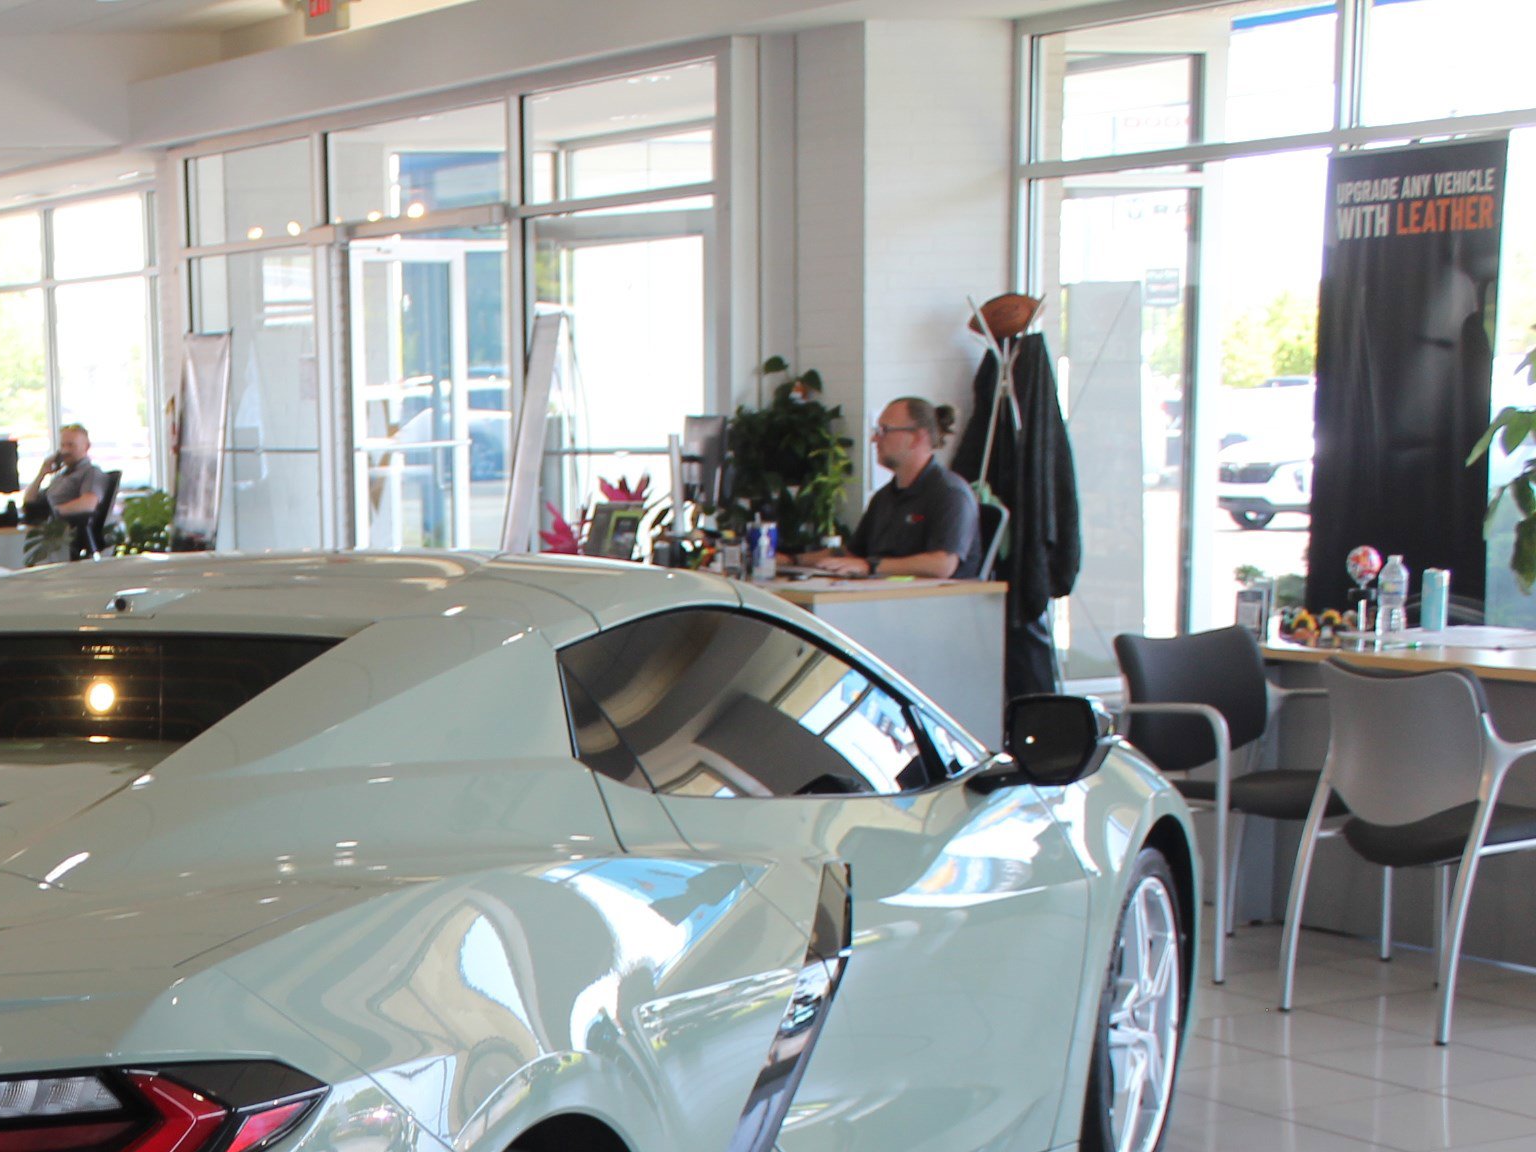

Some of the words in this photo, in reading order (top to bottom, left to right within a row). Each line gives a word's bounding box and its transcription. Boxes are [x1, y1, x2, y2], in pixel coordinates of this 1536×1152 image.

[1337, 177, 1399, 204] UPGRADE
[1401, 174, 1433, 199] ANY
[1434, 167, 1496, 195] VEHICLE
[1337, 203, 1390, 240] WITH
[1396, 194, 1496, 235] LEATHER
